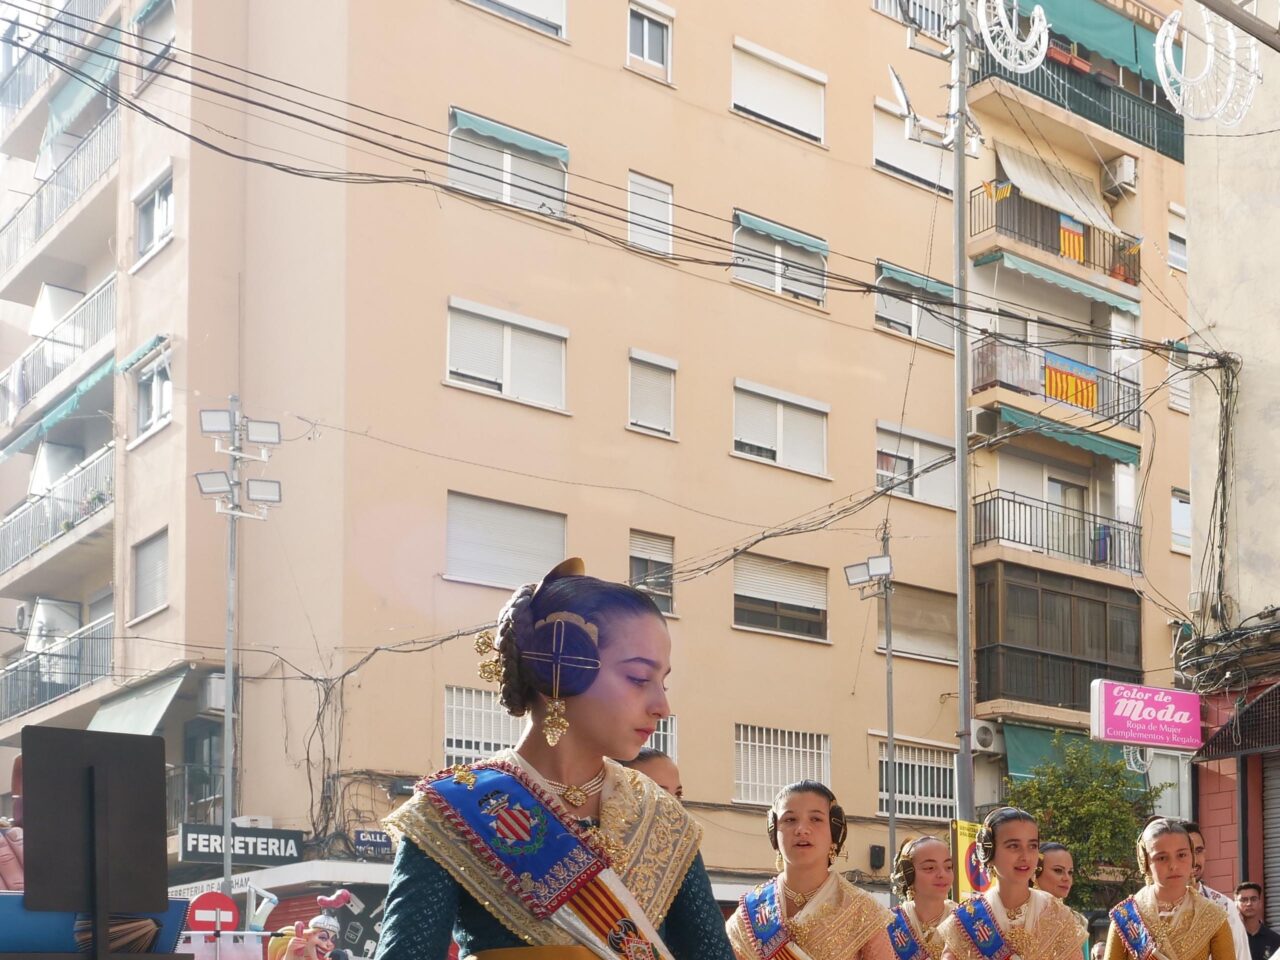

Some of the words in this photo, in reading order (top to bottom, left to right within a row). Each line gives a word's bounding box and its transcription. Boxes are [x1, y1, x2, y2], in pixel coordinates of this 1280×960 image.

[1112, 685, 1153, 700] Color
[1154, 691, 1172, 703] de
[1113, 698, 1193, 724] Moda
[1106, 726, 1165, 741] Complementos
[1165, 734, 1171, 743] y
[1171, 733, 1201, 745] Regalos
[1126, 720, 1146, 731] Ropa
[1147, 722, 1158, 732] de
[1159, 724, 1182, 734] Mujer
[187, 833, 299, 857] FERRETERIA
[360, 832, 387, 843] CALLE
